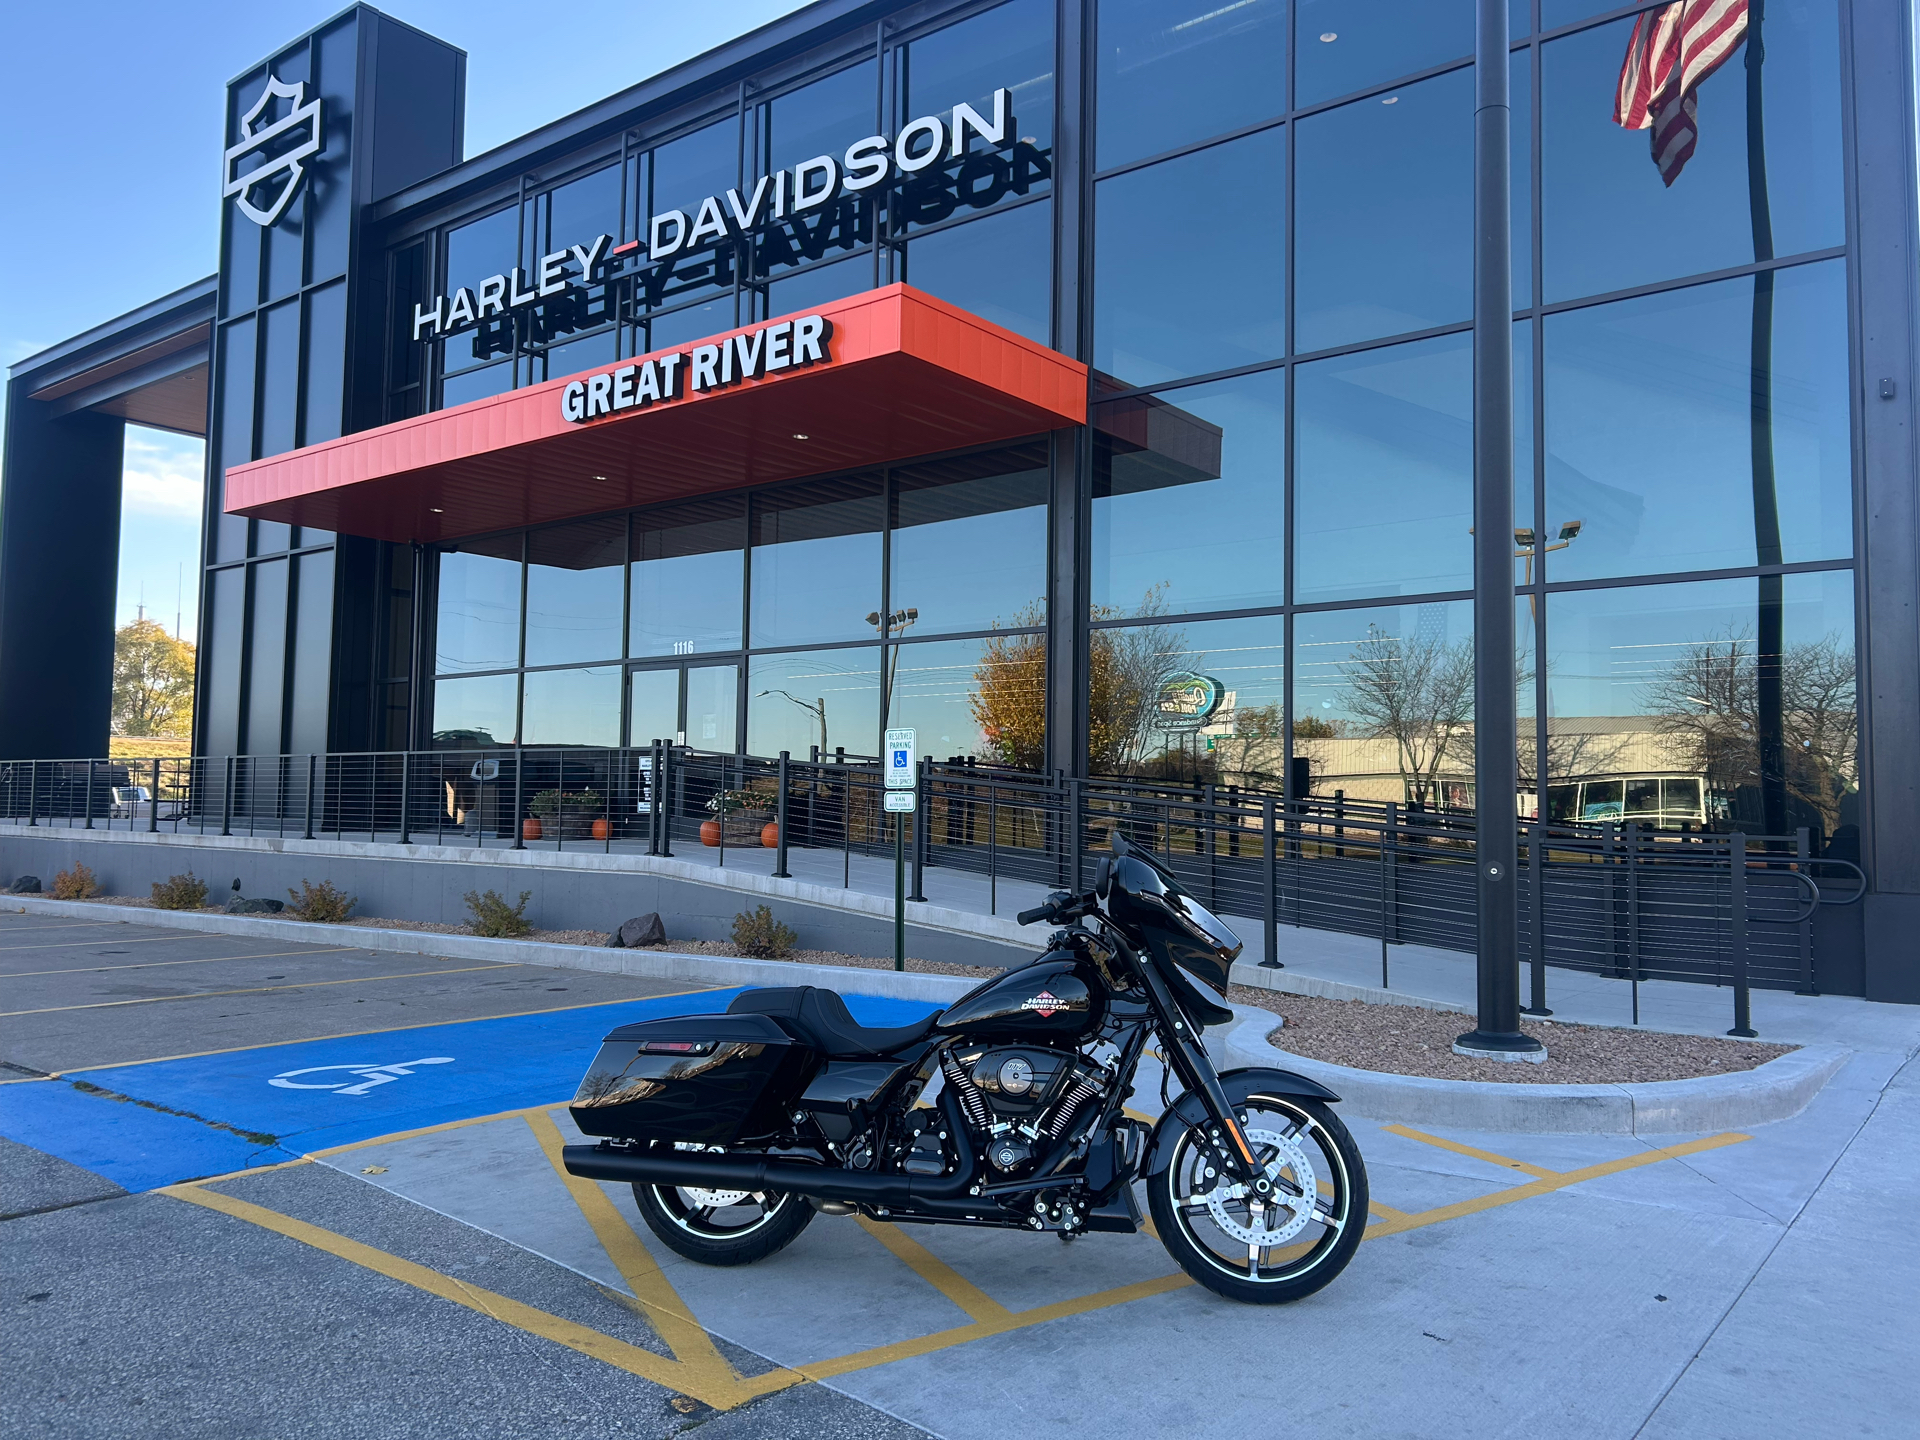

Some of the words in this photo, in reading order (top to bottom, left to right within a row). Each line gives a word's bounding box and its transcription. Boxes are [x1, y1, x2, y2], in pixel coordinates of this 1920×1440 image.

[413, 87, 1008, 341] HARLEY-DAVIDSON
[561, 353, 687, 422] GREAT
[691, 314, 829, 392] RIVER
[673, 640, 694, 655] 1116
[889, 732, 912, 740] RESERVED
[890, 741, 911, 749] PARKING
